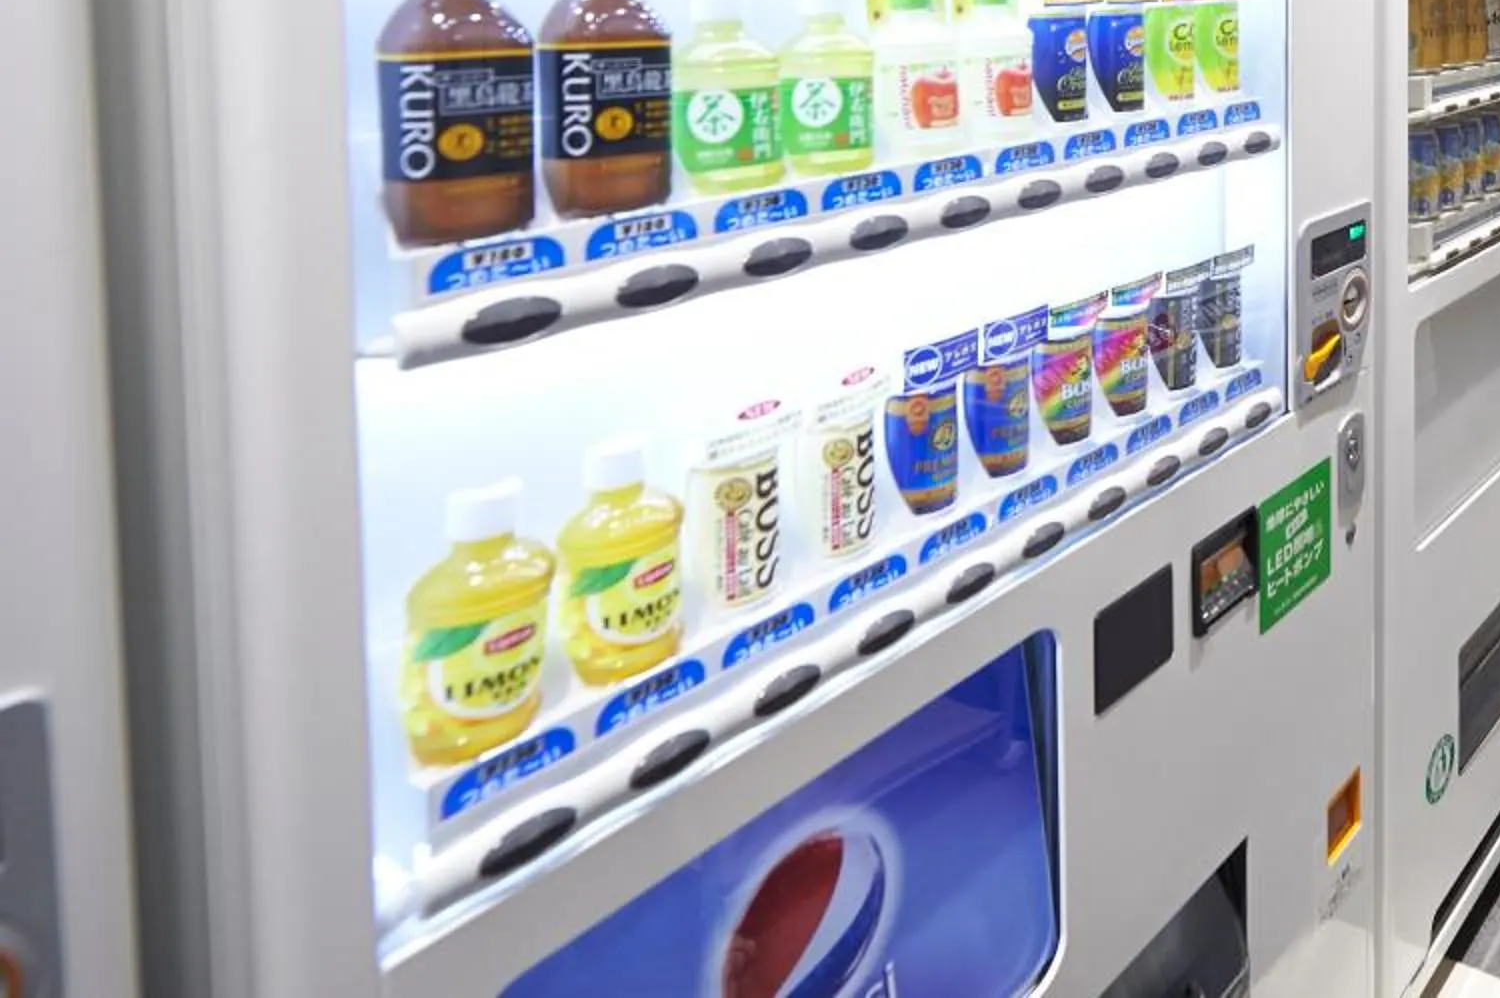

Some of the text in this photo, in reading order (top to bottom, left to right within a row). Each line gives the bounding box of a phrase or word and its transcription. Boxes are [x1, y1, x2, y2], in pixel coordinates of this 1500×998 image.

[400, 63, 436, 180] KURO
[561, 52, 593, 157] KURO
[756, 468, 779, 589] BOSS
[857, 428, 875, 539] BOSS
